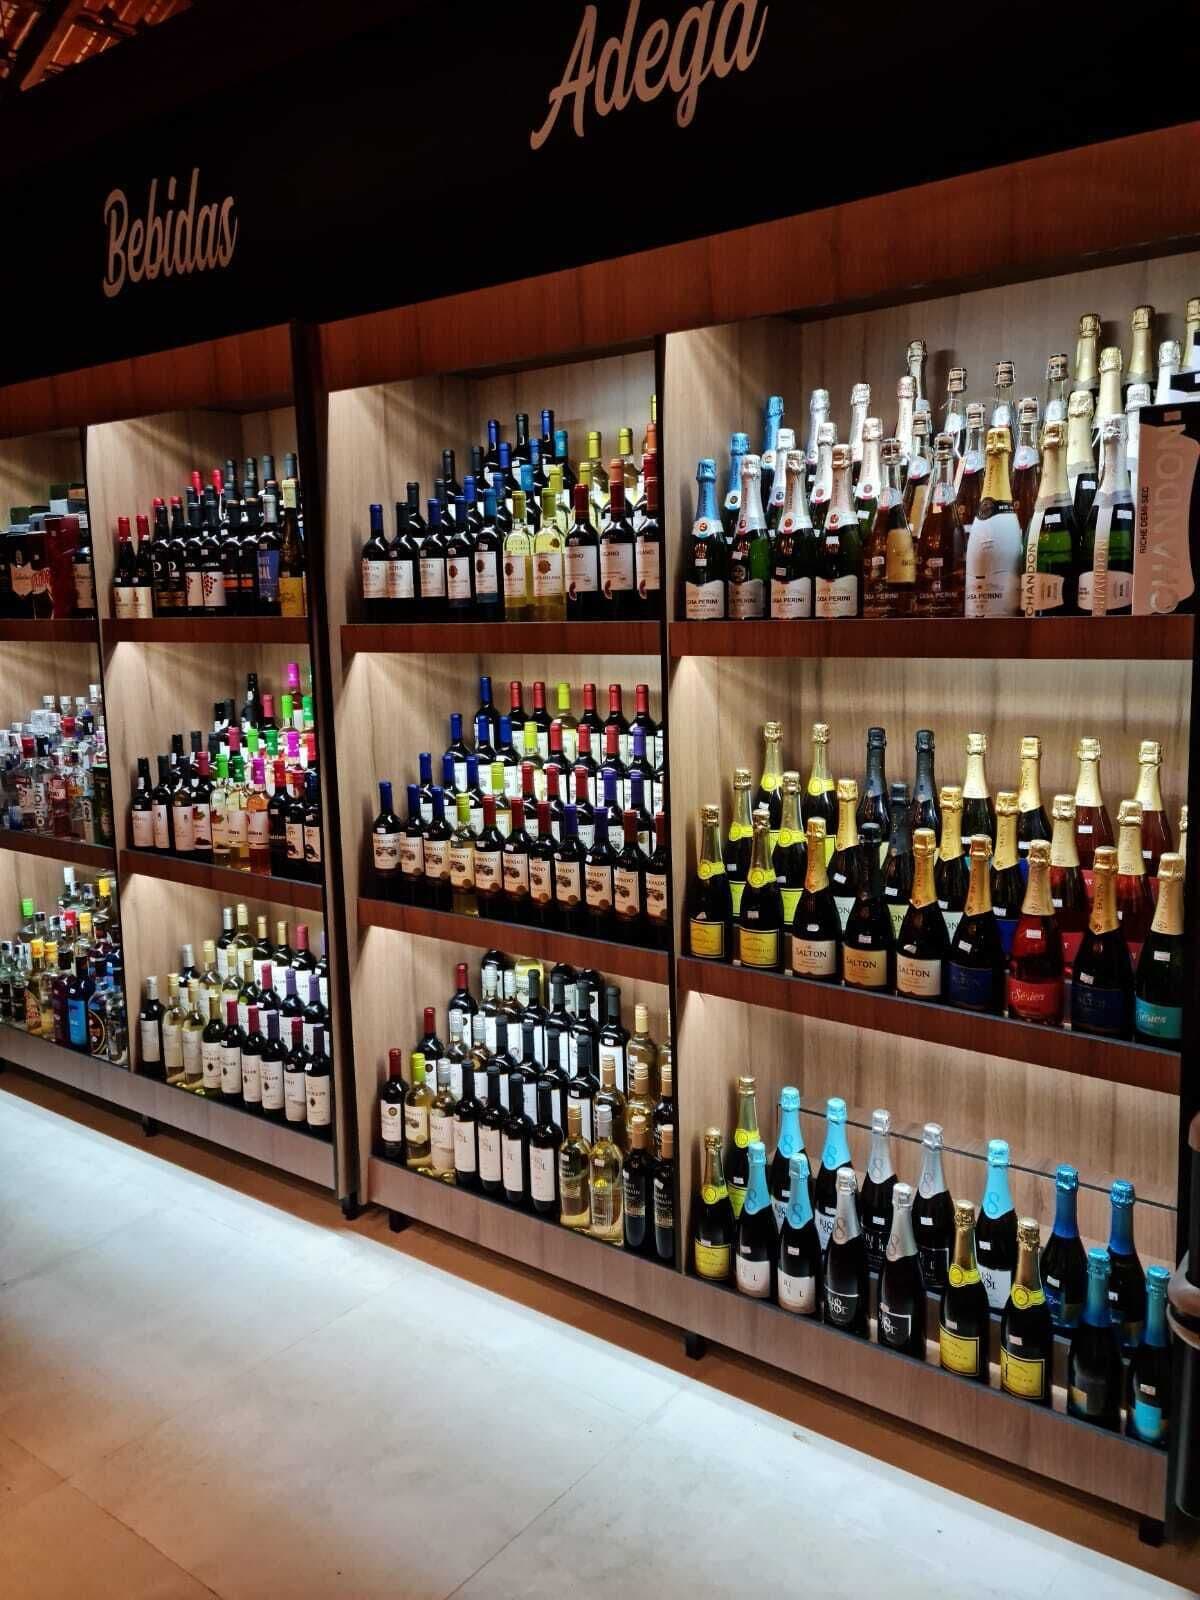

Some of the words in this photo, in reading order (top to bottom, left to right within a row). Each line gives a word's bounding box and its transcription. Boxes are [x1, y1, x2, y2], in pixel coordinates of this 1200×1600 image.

[530, 0, 768, 150] Adega
[103, 167, 238, 298] Bebidas
[1026, 543, 1036, 617] CHANDON
[1151, 424, 1186, 614] CHANDON
[796, 948, 828, 958] SALTON
